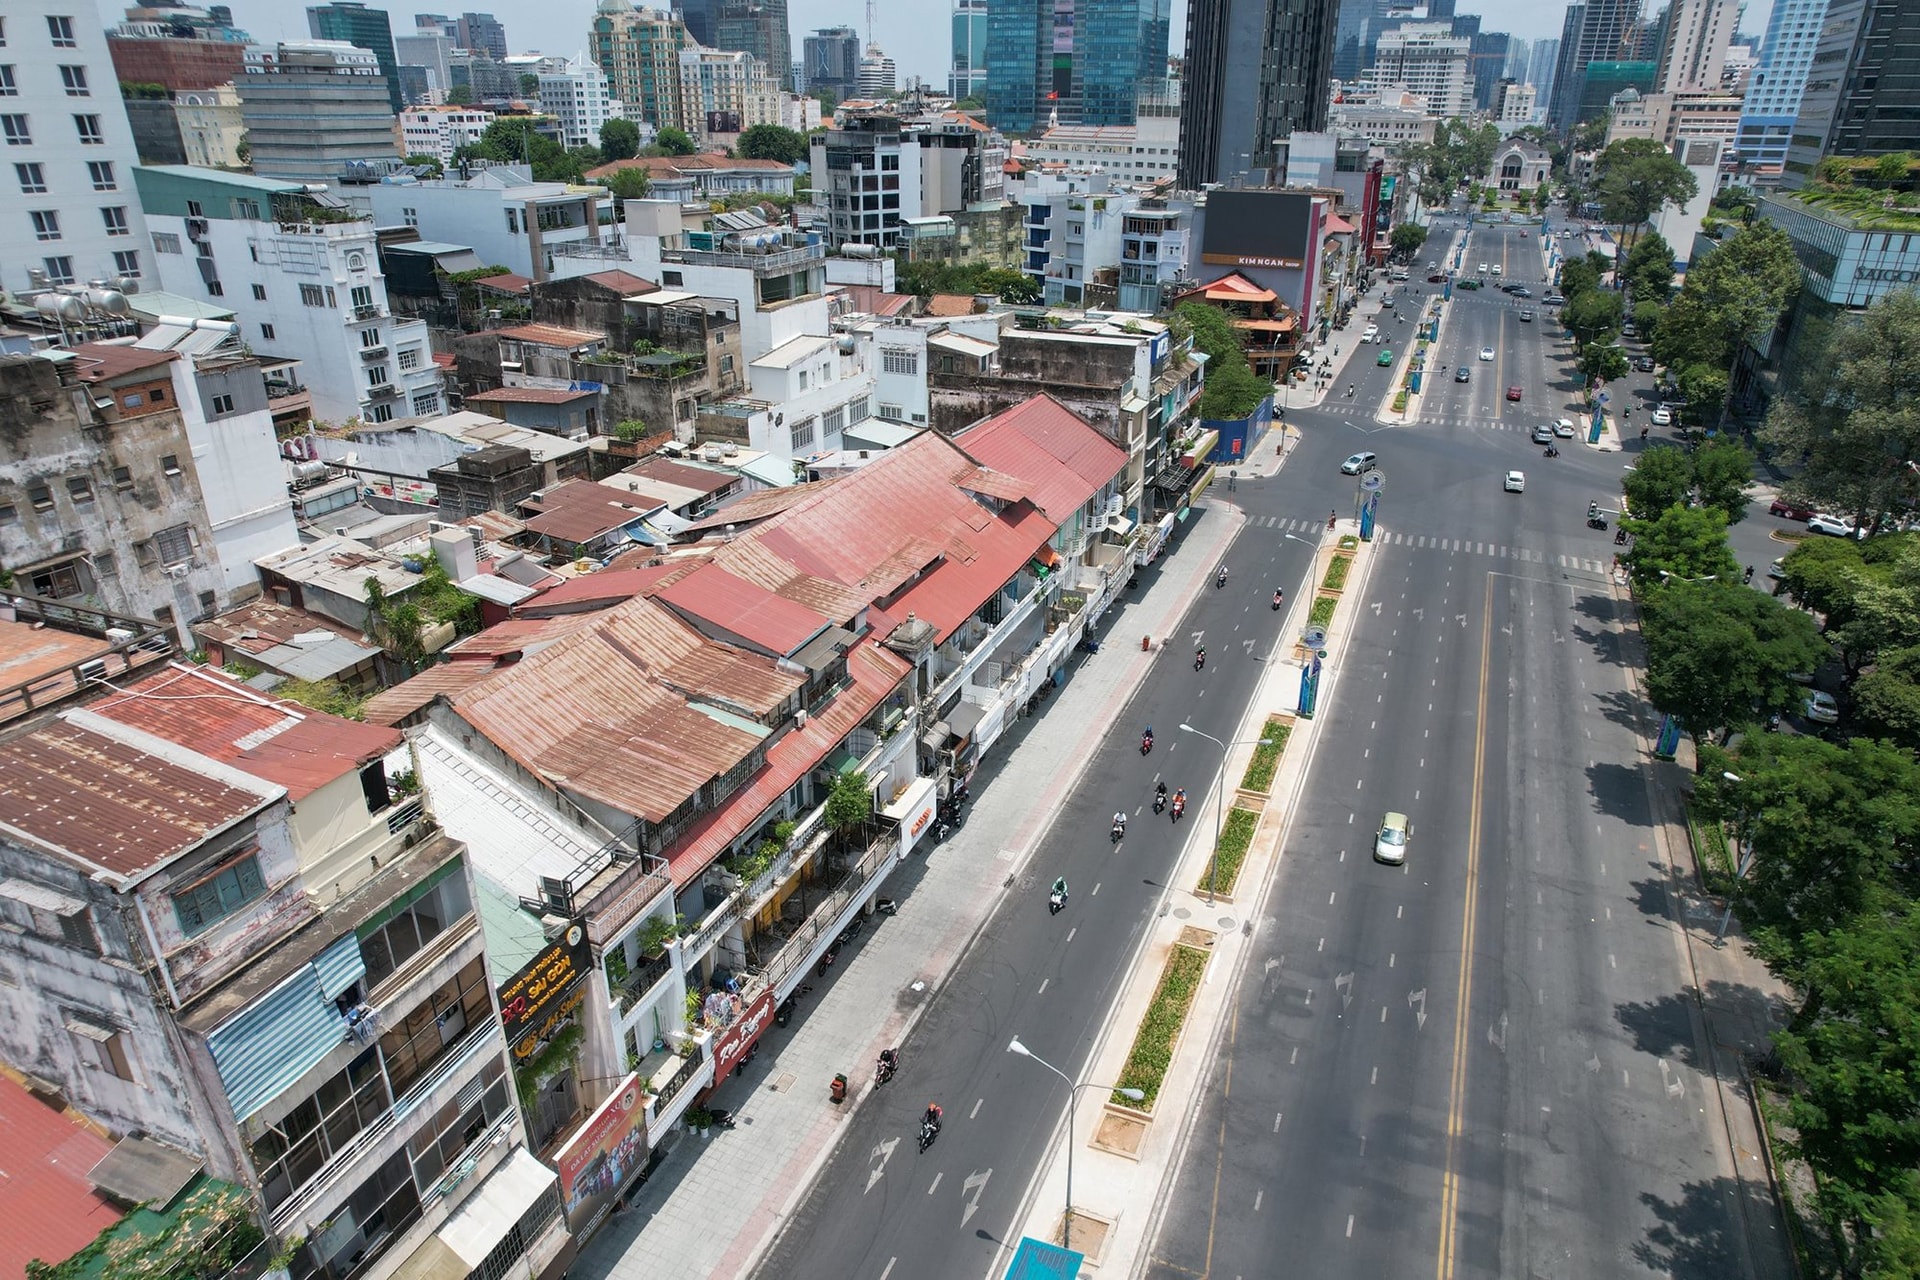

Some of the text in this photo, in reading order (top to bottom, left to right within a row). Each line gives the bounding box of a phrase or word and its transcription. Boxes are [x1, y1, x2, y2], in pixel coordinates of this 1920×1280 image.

[1238, 257, 1256, 265] KIM
[1257, 258, 1284, 266] NGAN
[528, 976, 548, 1000] SÀI
[546, 955, 572, 982] GÒN
[501, 995, 526, 1025] XQ
